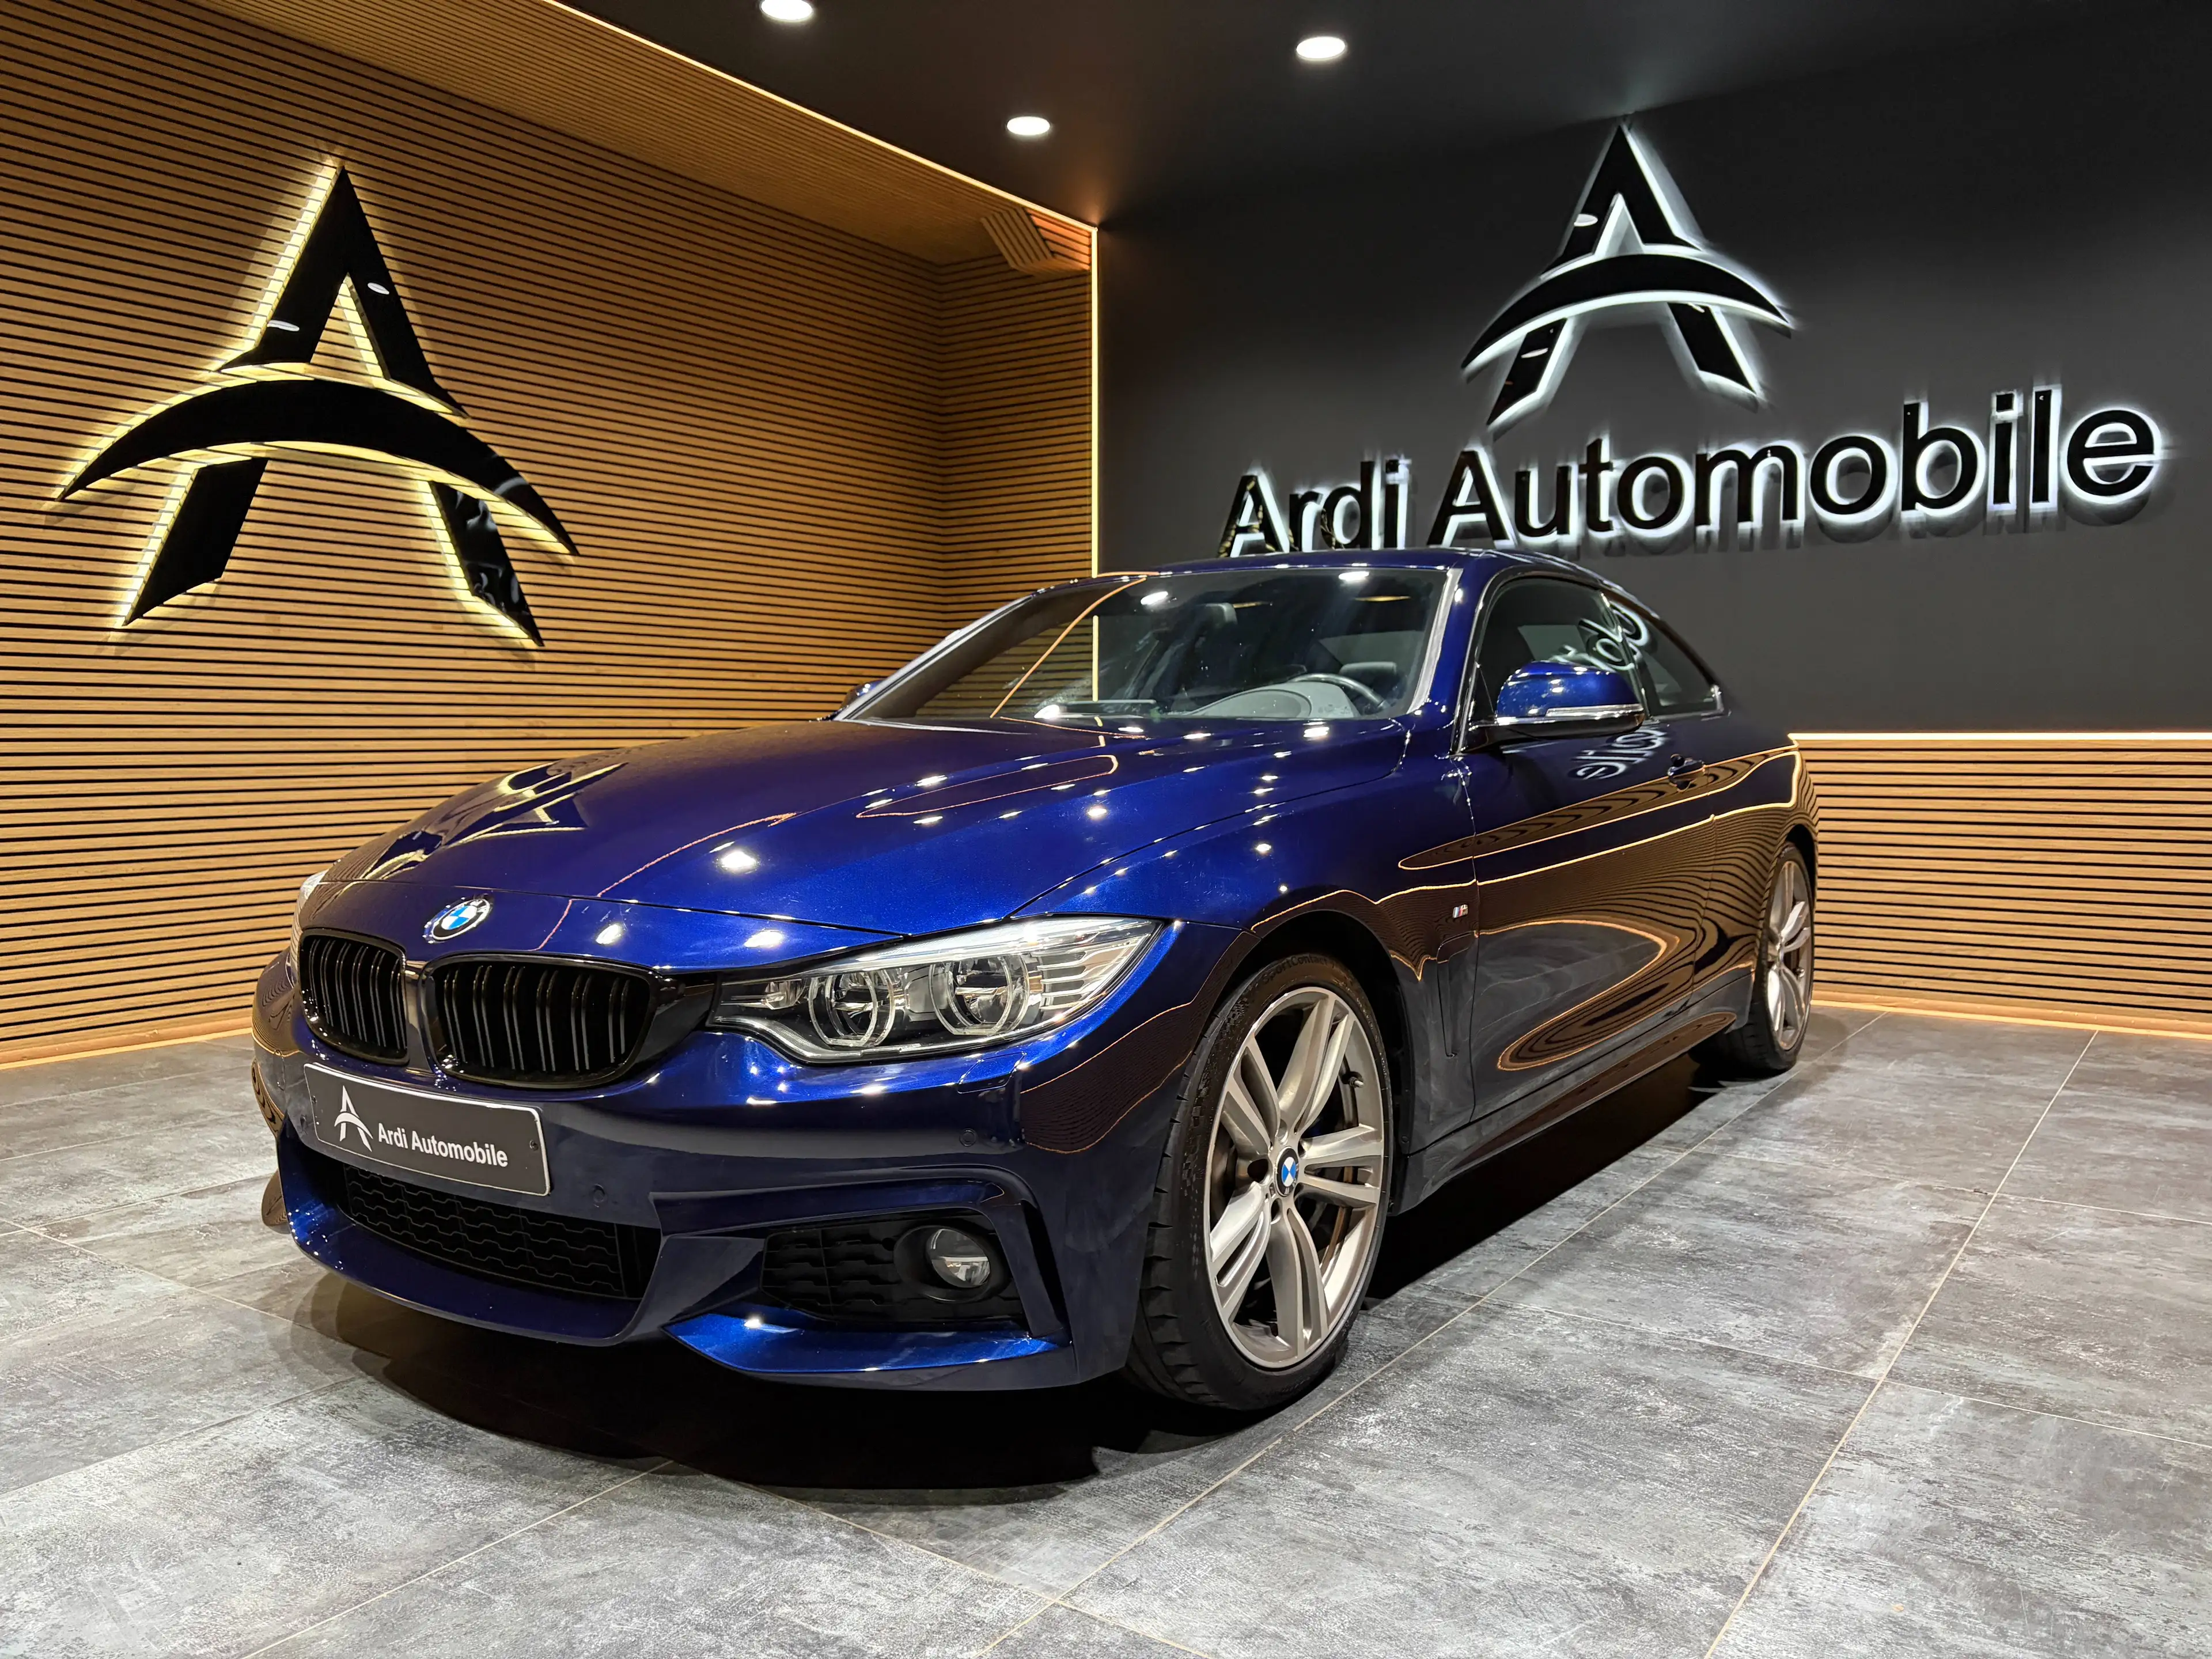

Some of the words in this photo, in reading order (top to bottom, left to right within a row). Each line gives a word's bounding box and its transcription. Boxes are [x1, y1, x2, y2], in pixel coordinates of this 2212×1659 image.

[1217, 459, 1402, 558] Ardi
[1426, 388, 2157, 547] Automobile
[378, 1123, 408, 1149] Ardi
[411, 1130, 509, 1168] Automobile
